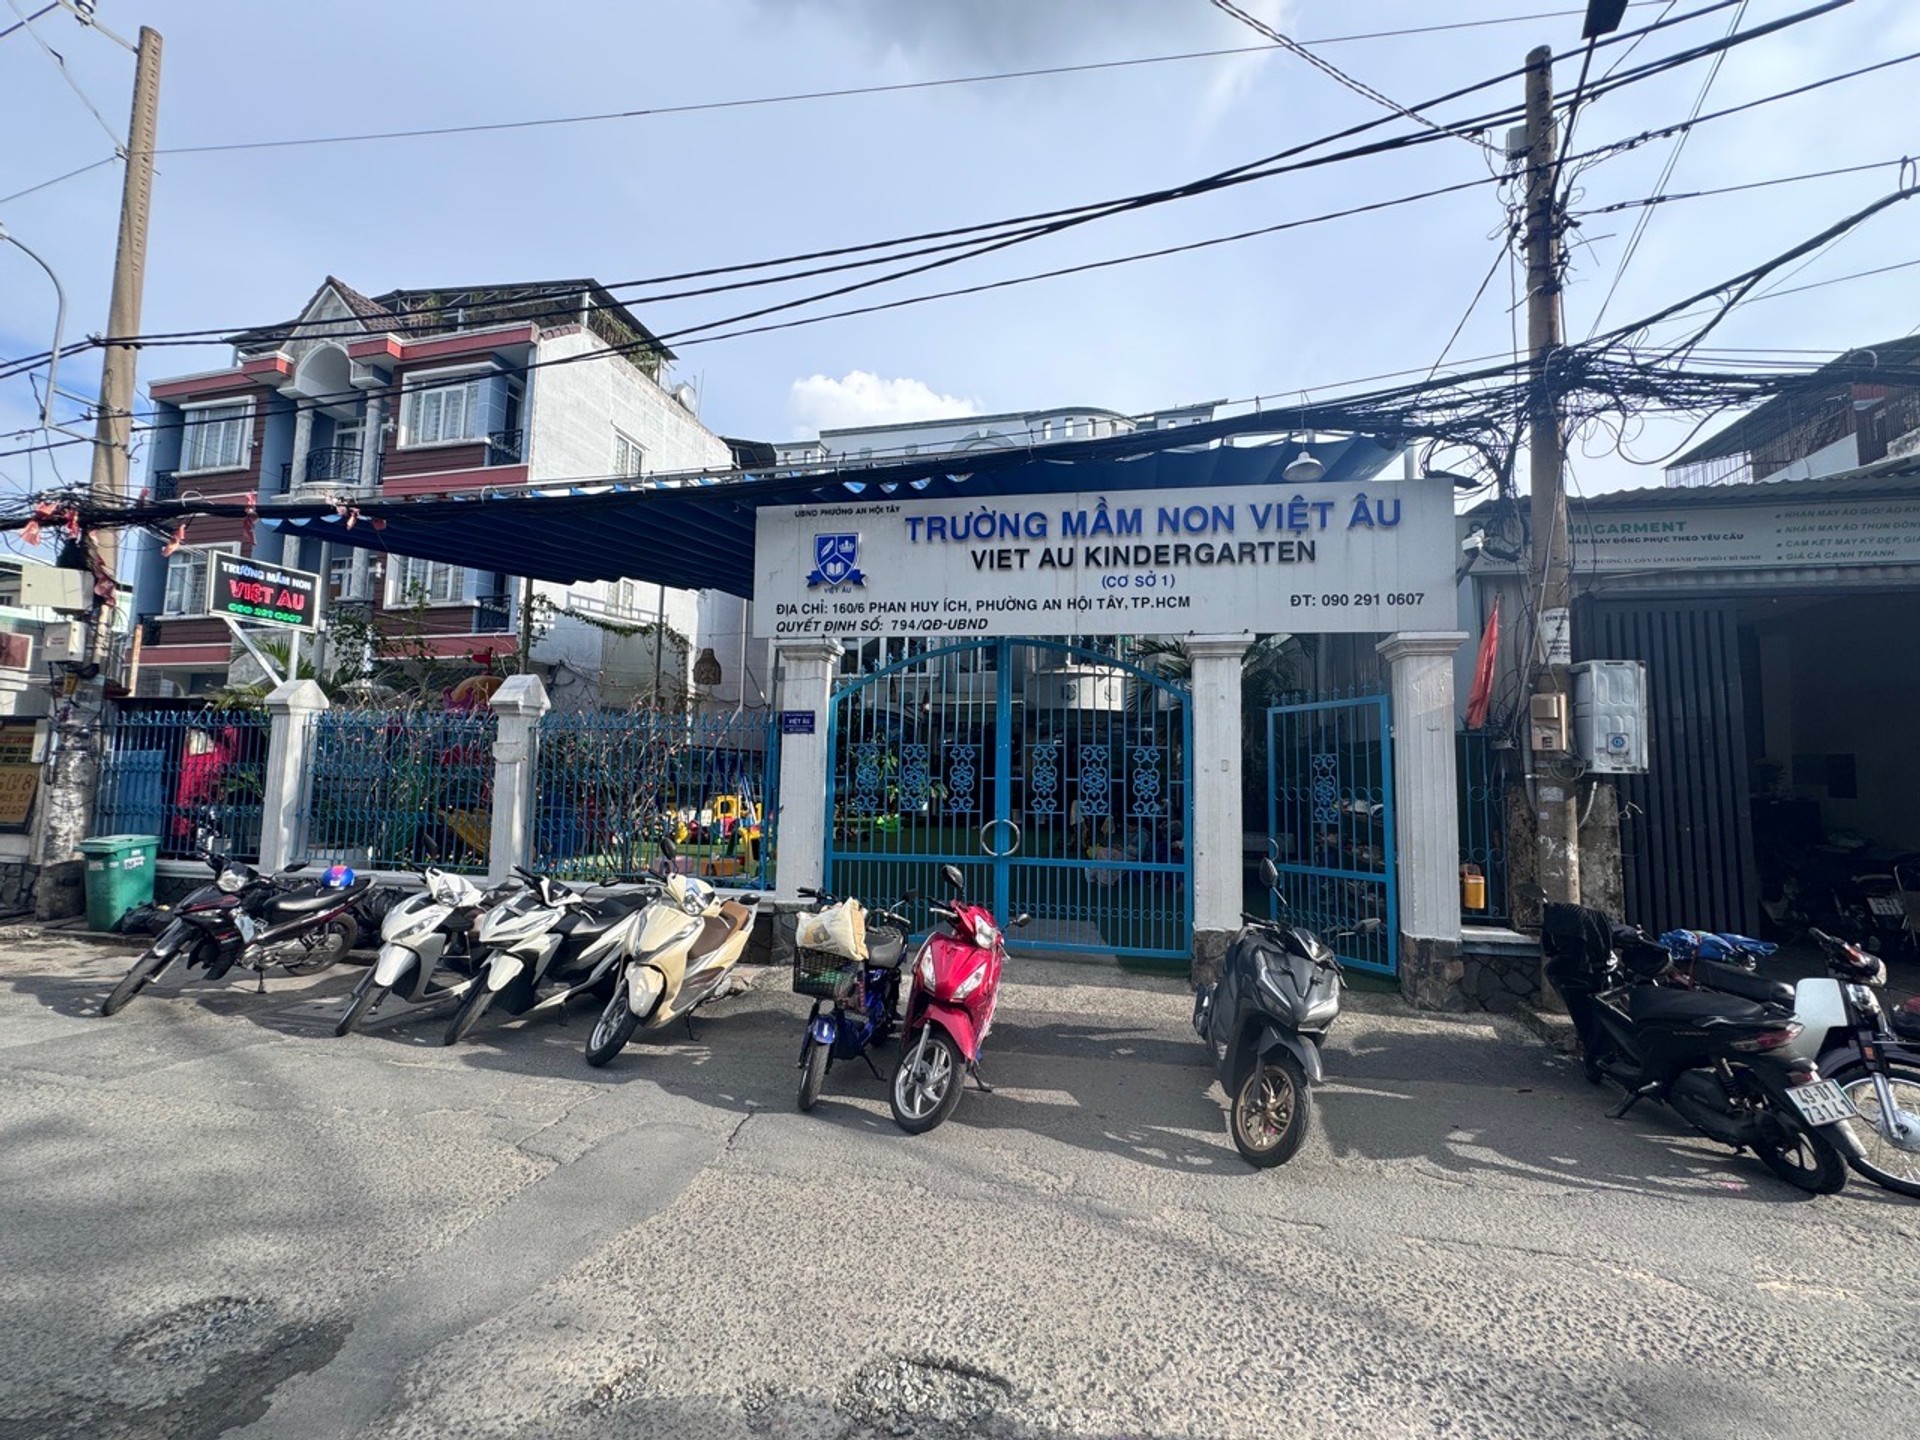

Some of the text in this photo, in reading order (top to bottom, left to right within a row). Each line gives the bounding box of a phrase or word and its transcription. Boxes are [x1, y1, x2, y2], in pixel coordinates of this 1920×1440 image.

[794, 509, 818, 518] UBND
[869, 506, 884, 515] HỘI
[886, 504, 900, 514] TÂY
[904, 492, 1401, 542] TRƯỜNG MẦM NON VIỆT ÂU
[1594, 521, 1687, 534] GARMENT
[1862, 521, 1890, 530] THUN
[1643, 535, 1671, 544] PHỤC
[1672, 534, 1699, 542] THEO
[1701, 532, 1722, 541] YÊU
[970, 540, 1316, 571] VIET AU KINDERGARTEN
[292, 578, 312, 591] NON
[1102, 570, 1176, 590] (CƠ SỞ 1)
[229, 580, 274, 604] VIỆT
[1290, 592, 1424, 607] ĐT: 090 291 0607
[776, 594, 1190, 616] ĐỊA CHỈ: 160/6 PHAN HUY ÍCH, PHƯỜNG AN HỘI TÂY, TP.HCM
[776, 616, 822, 632] QUYẾT
[824, 620, 857, 634] ĐỊNH
[860, 616, 884, 632] SỐ:
